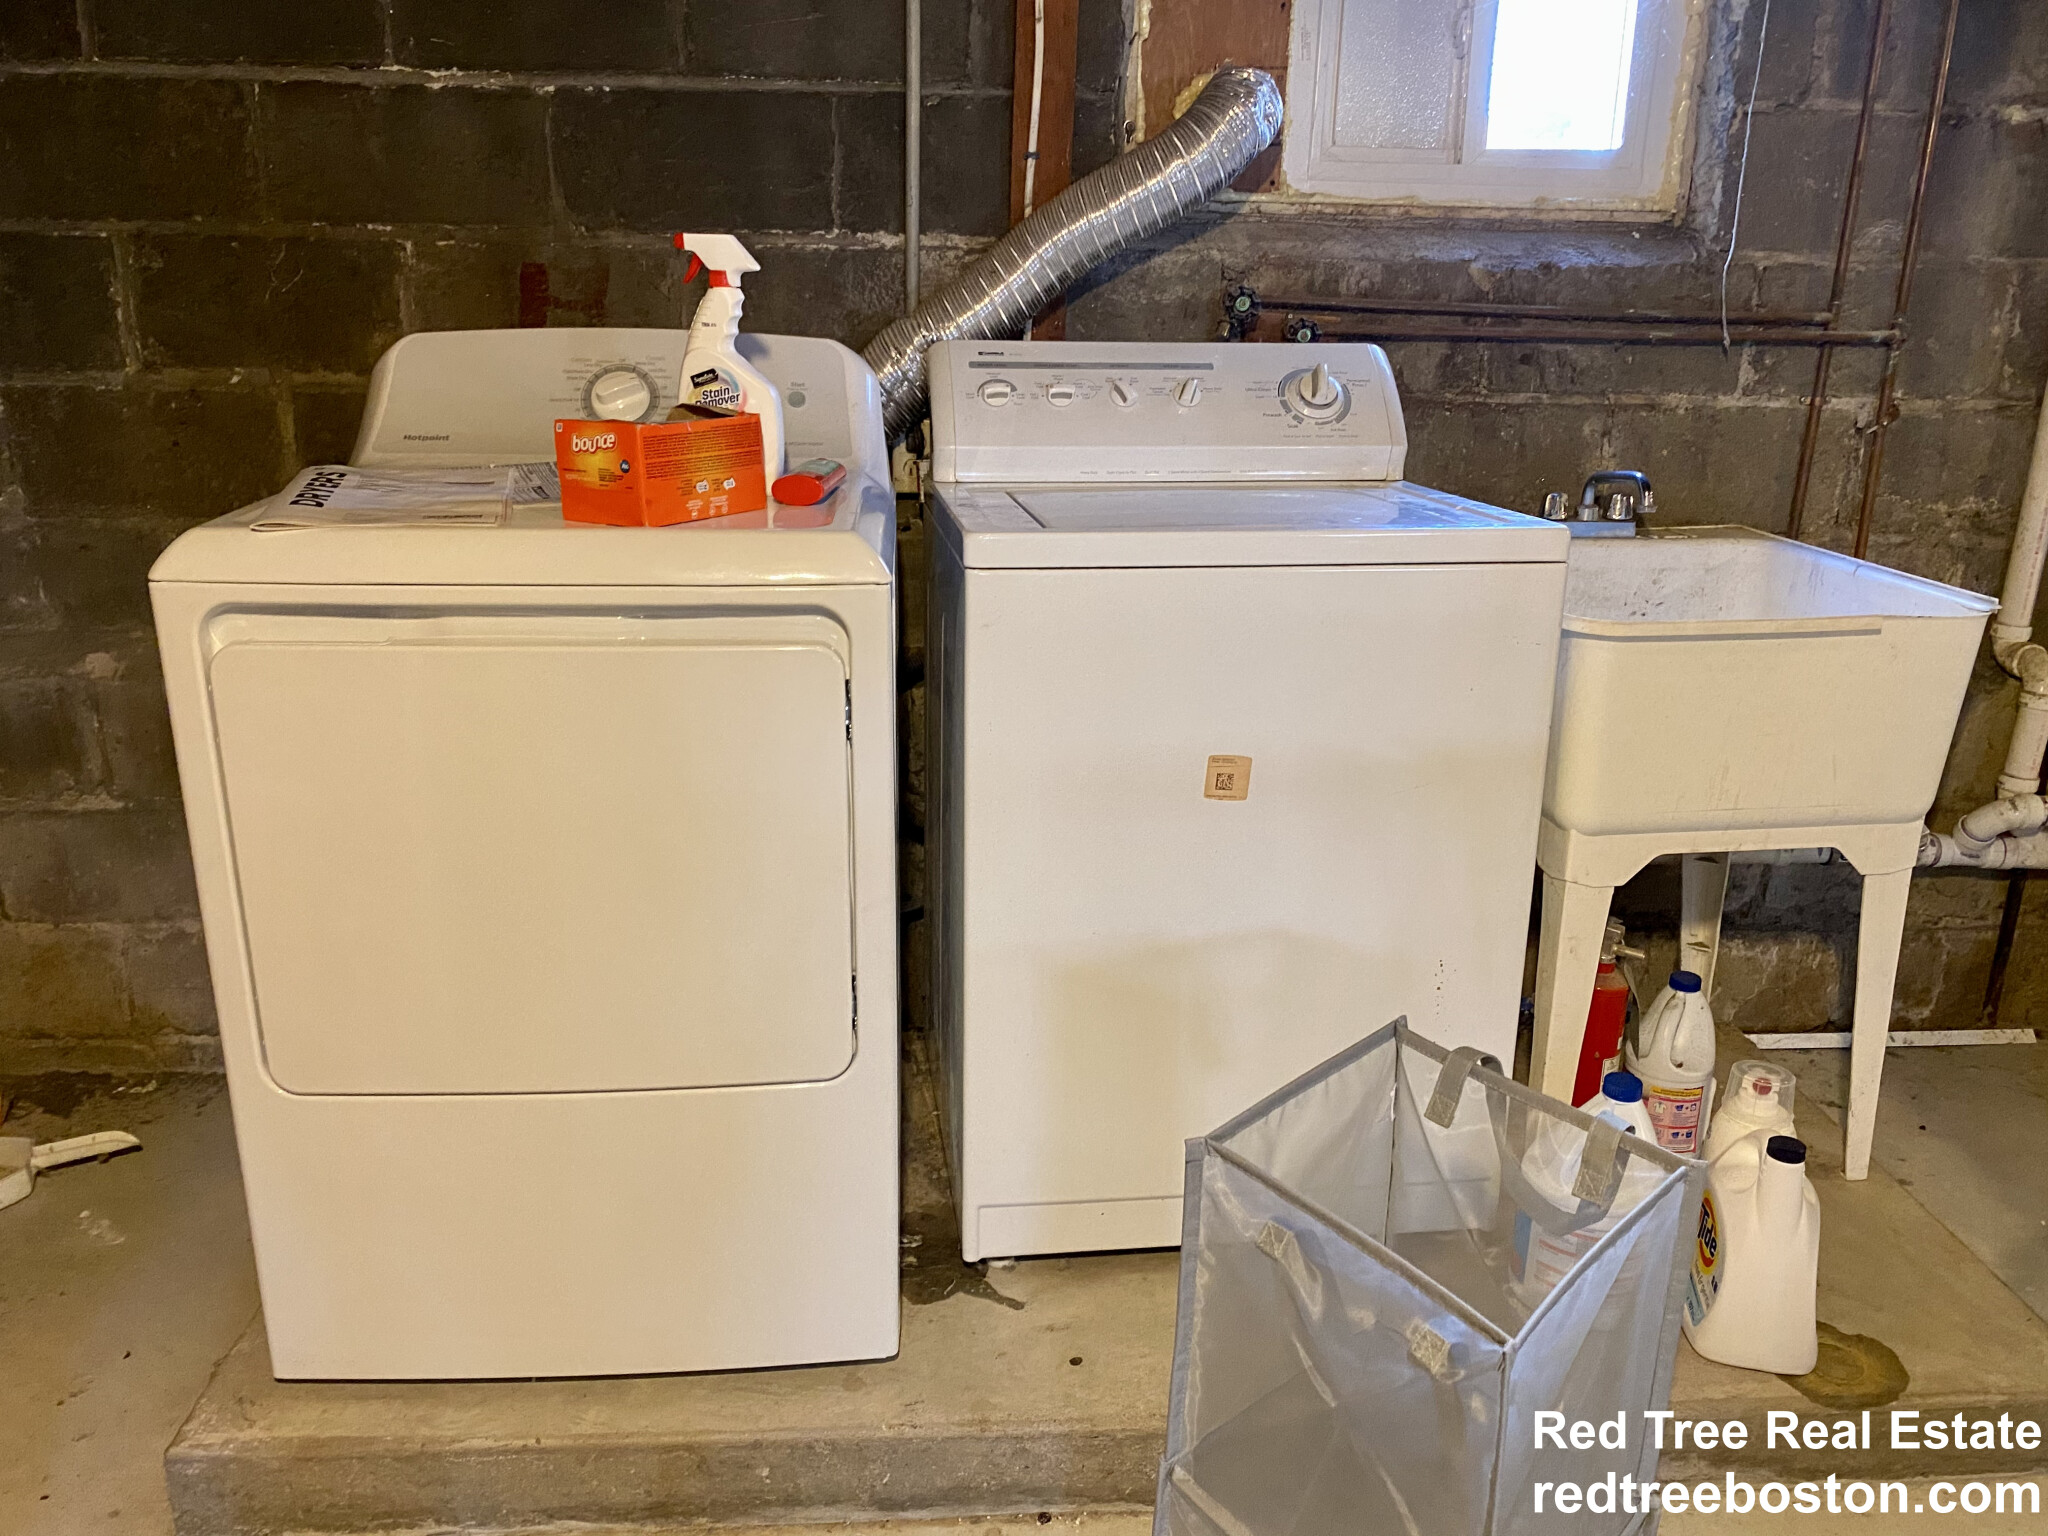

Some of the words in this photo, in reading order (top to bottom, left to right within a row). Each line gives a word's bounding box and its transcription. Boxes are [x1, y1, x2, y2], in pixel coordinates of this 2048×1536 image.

[702, 386, 730, 400] Stain
[403, 434, 450, 442] Hotpoint
[571, 433, 617, 453] bounce
[289, 471, 347, 508] DRYERS
[1697, 1201, 1717, 1258] Tide
